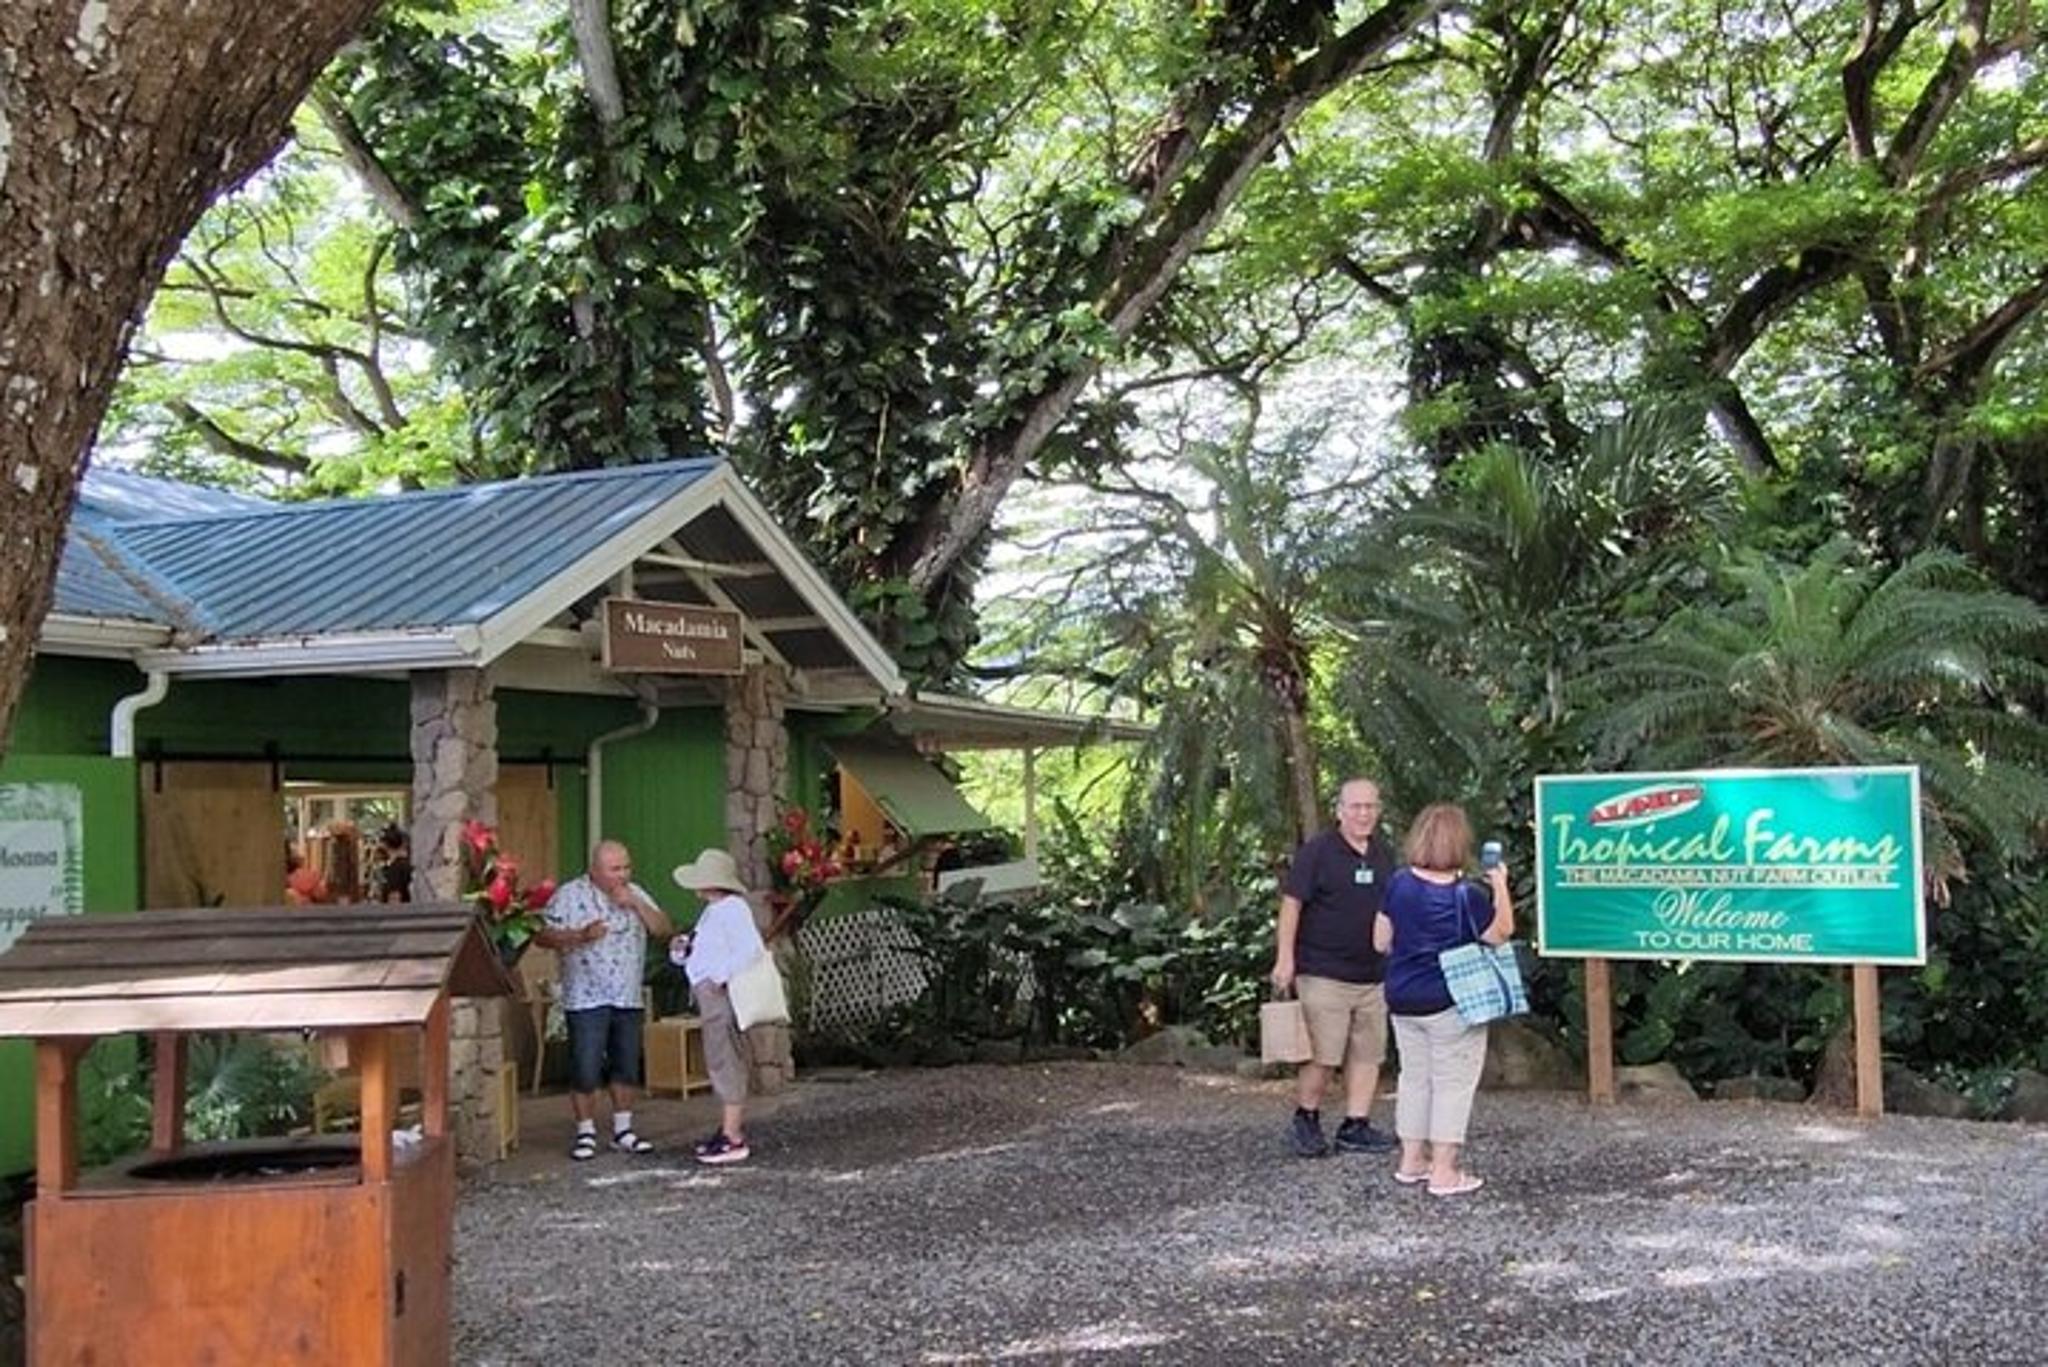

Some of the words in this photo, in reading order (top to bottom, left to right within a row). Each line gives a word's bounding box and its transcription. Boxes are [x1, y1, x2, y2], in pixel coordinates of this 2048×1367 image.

[624, 612, 727, 638] Macadamia
[661, 642, 696, 659] Nuts
[1551, 814, 1735, 866] Tropical
[1744, 808, 1904, 865] Farms
[1565, 867, 1595, 882] THE
[1600, 867, 1707, 882] MACADAMIA
[1711, 867, 1748, 882] NUT
[1754, 867, 1809, 882] FARM
[1812, 867, 1889, 882] OUTLET
[1652, 886, 1789, 932] Welcome
[1633, 931, 1670, 949] TO
[1675, 931, 1731, 950] OUR
[1736, 933, 1813, 952] HOME
